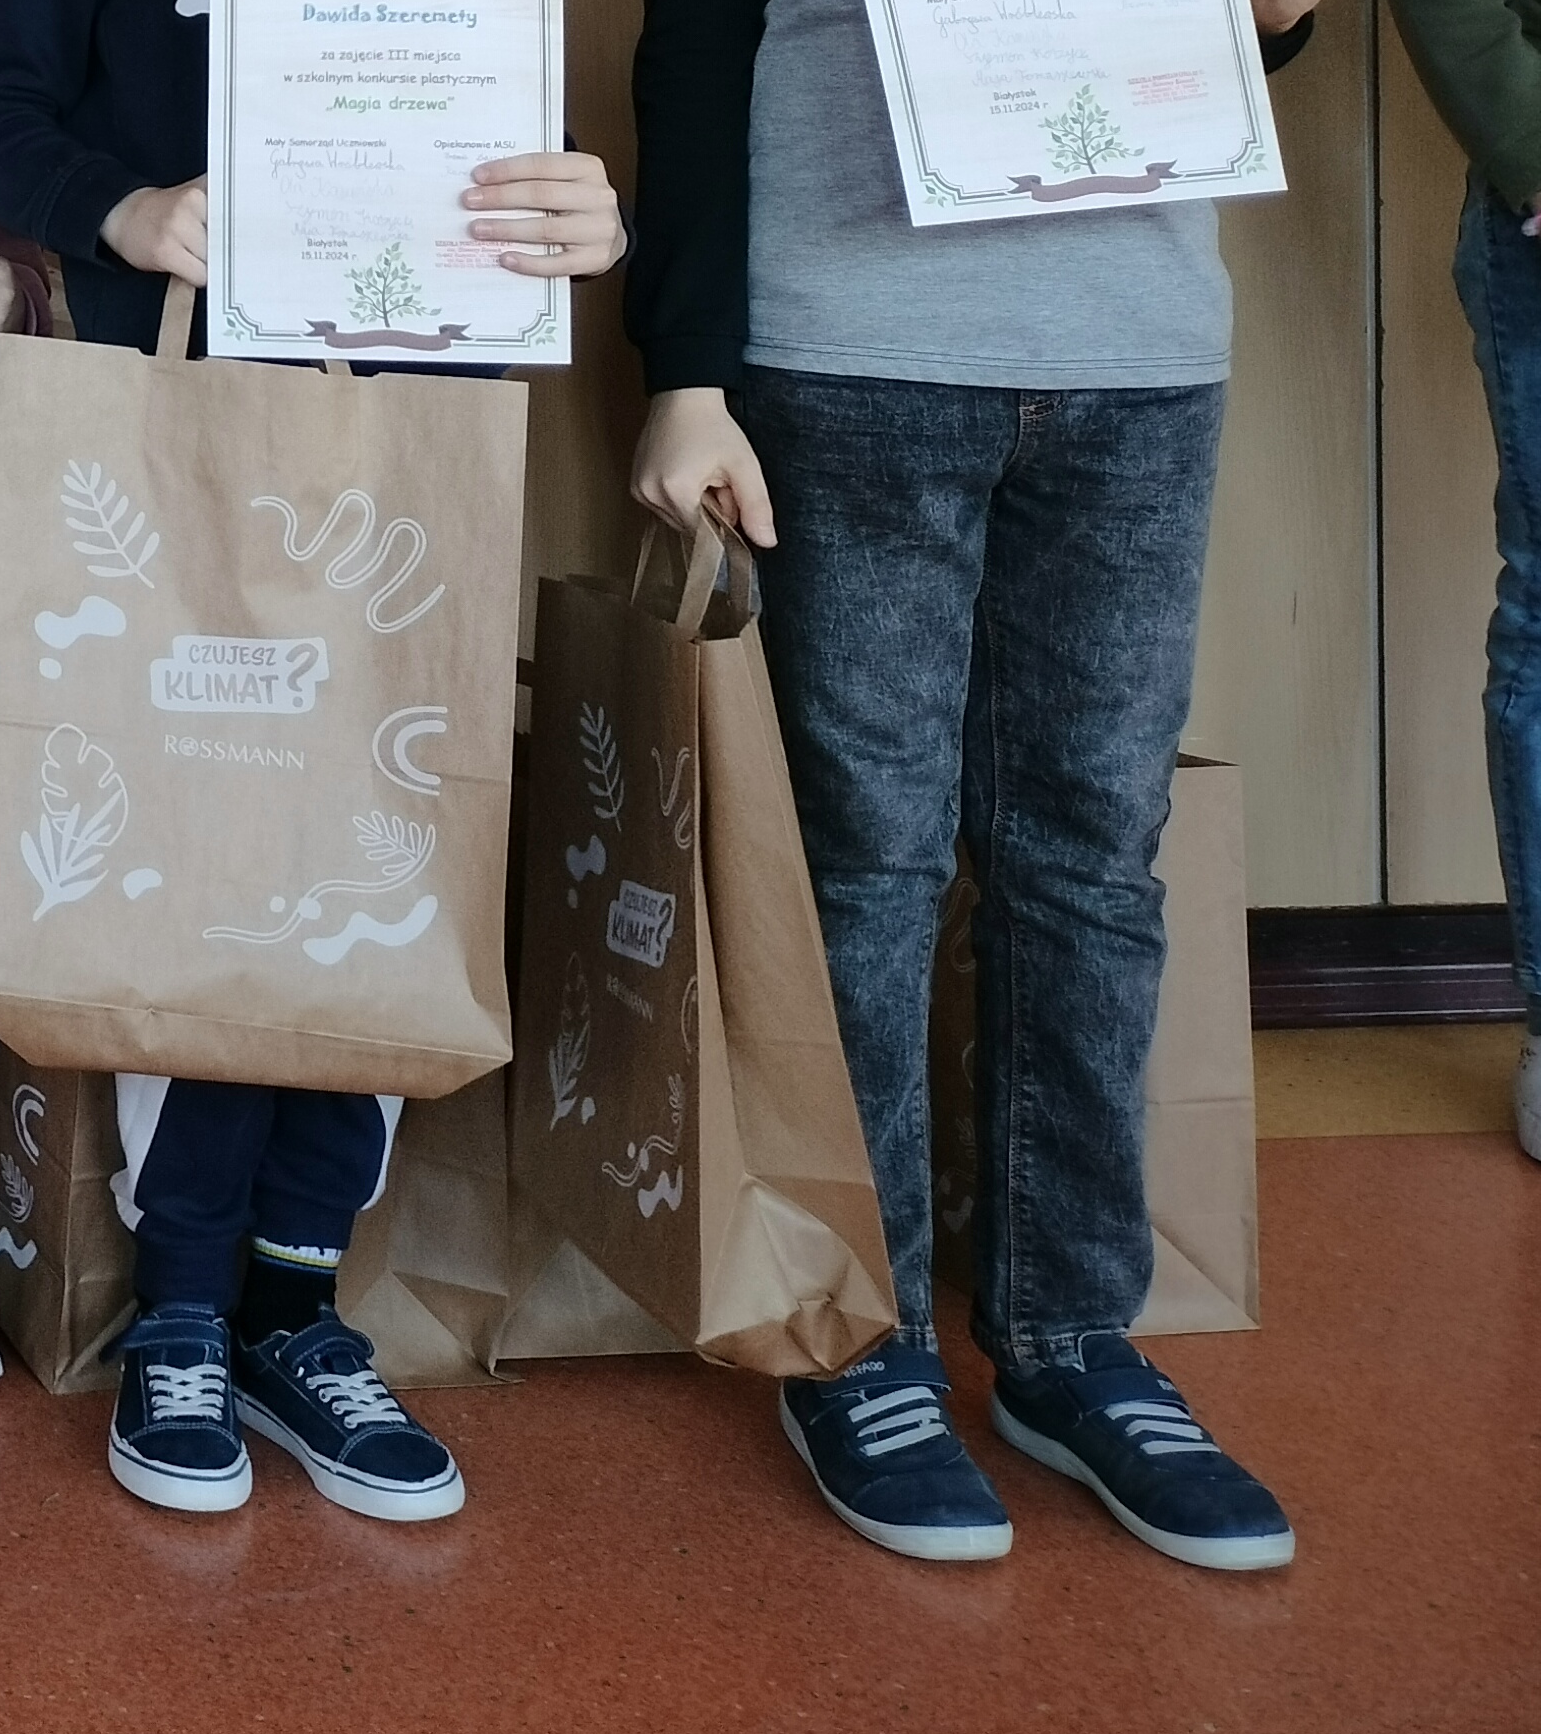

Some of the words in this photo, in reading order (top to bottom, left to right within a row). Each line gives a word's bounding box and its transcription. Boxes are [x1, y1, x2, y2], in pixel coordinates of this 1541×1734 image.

[303, 4, 371, 23] Dawida
[376, 4, 477, 28] Szeremety
[321, 52, 335, 61] za
[339, 51, 383, 63] zajęcie
[388, 49, 409, 60] III
[413, 51, 461, 63] miejsca
[297, 72, 353, 85] szkolnym
[358, 72, 417, 83] konkursie
[421, 73, 496, 87] plastycznym
[189, 644, 276, 666] CZUJESZ
[165, 734, 304, 770] ROSSMANN
